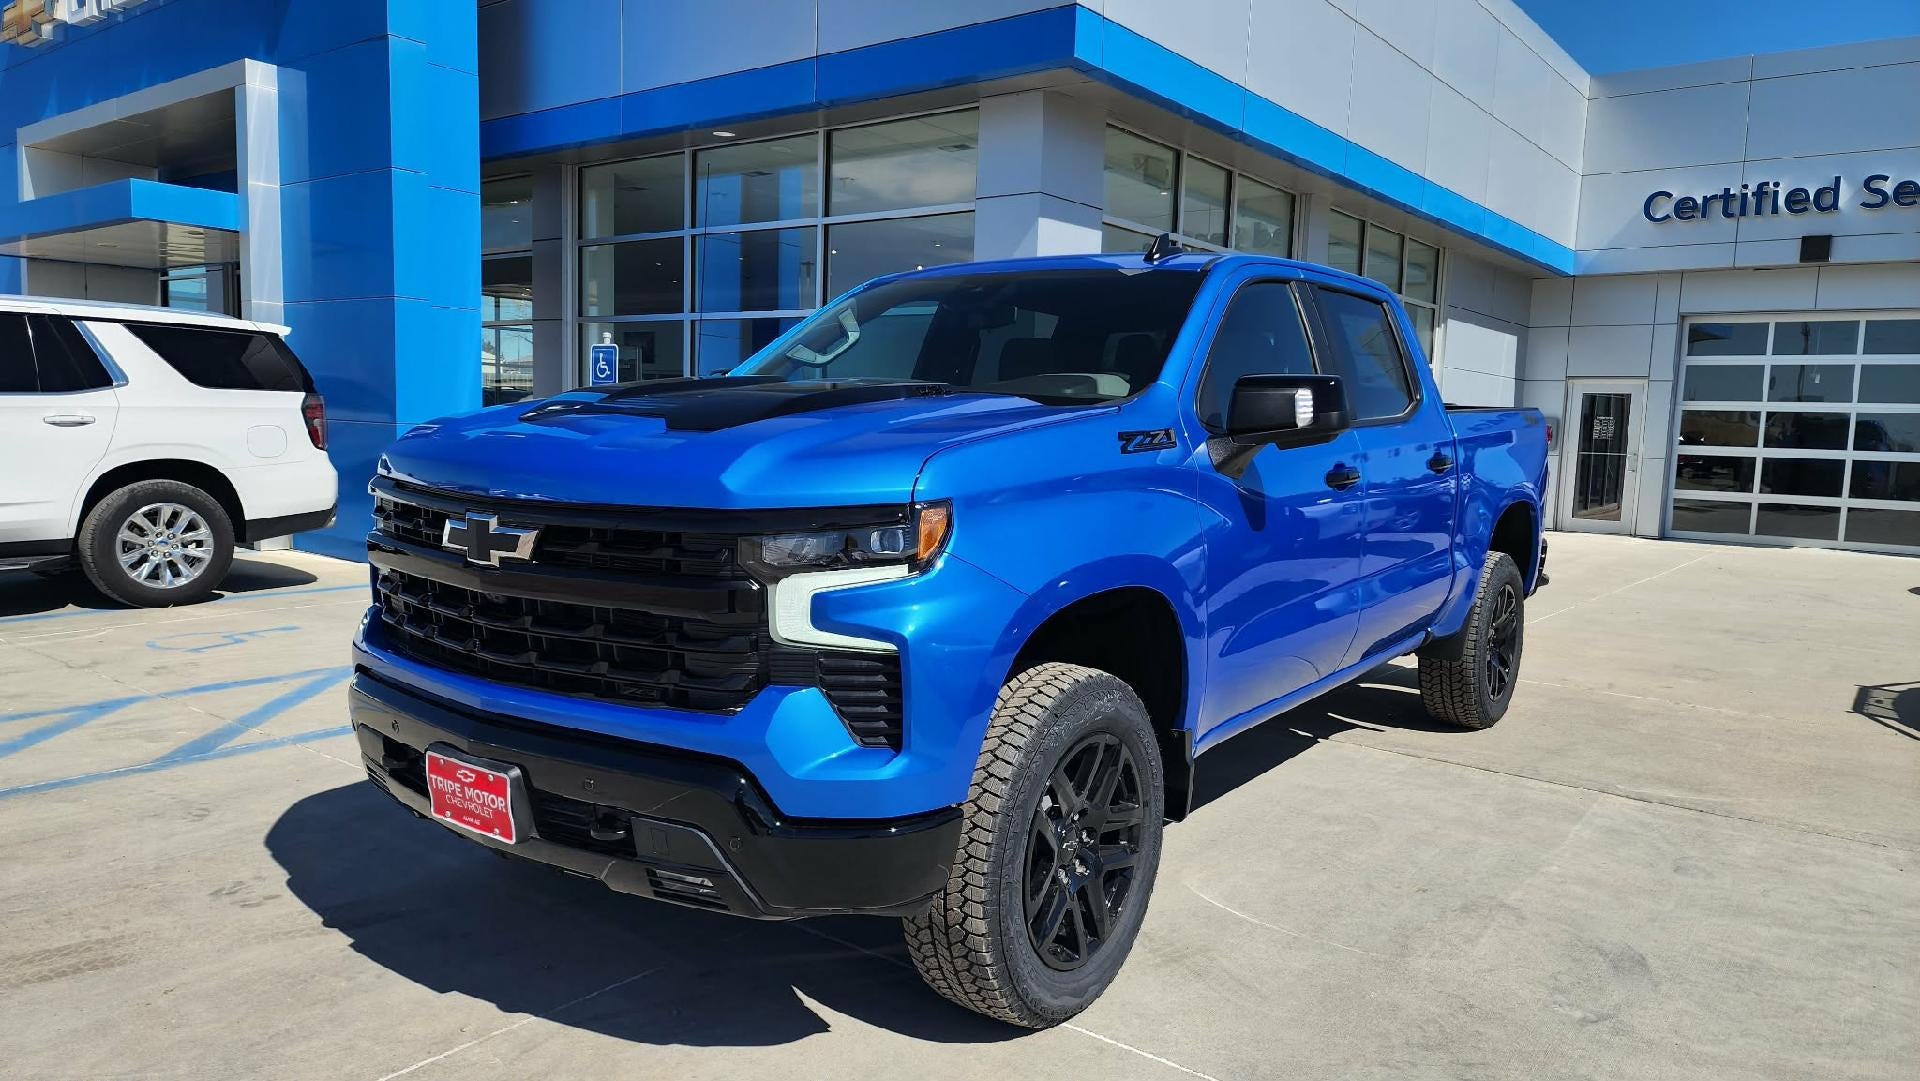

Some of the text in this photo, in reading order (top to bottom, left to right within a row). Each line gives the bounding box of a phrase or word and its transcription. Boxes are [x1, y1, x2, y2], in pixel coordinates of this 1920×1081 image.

[1643, 173, 1920, 223] Certified Se
[1118, 427, 1177, 454] Z71
[429, 773, 507, 813] TRIPE MOTOR
[445, 794, 494, 819] CHEVROLET
